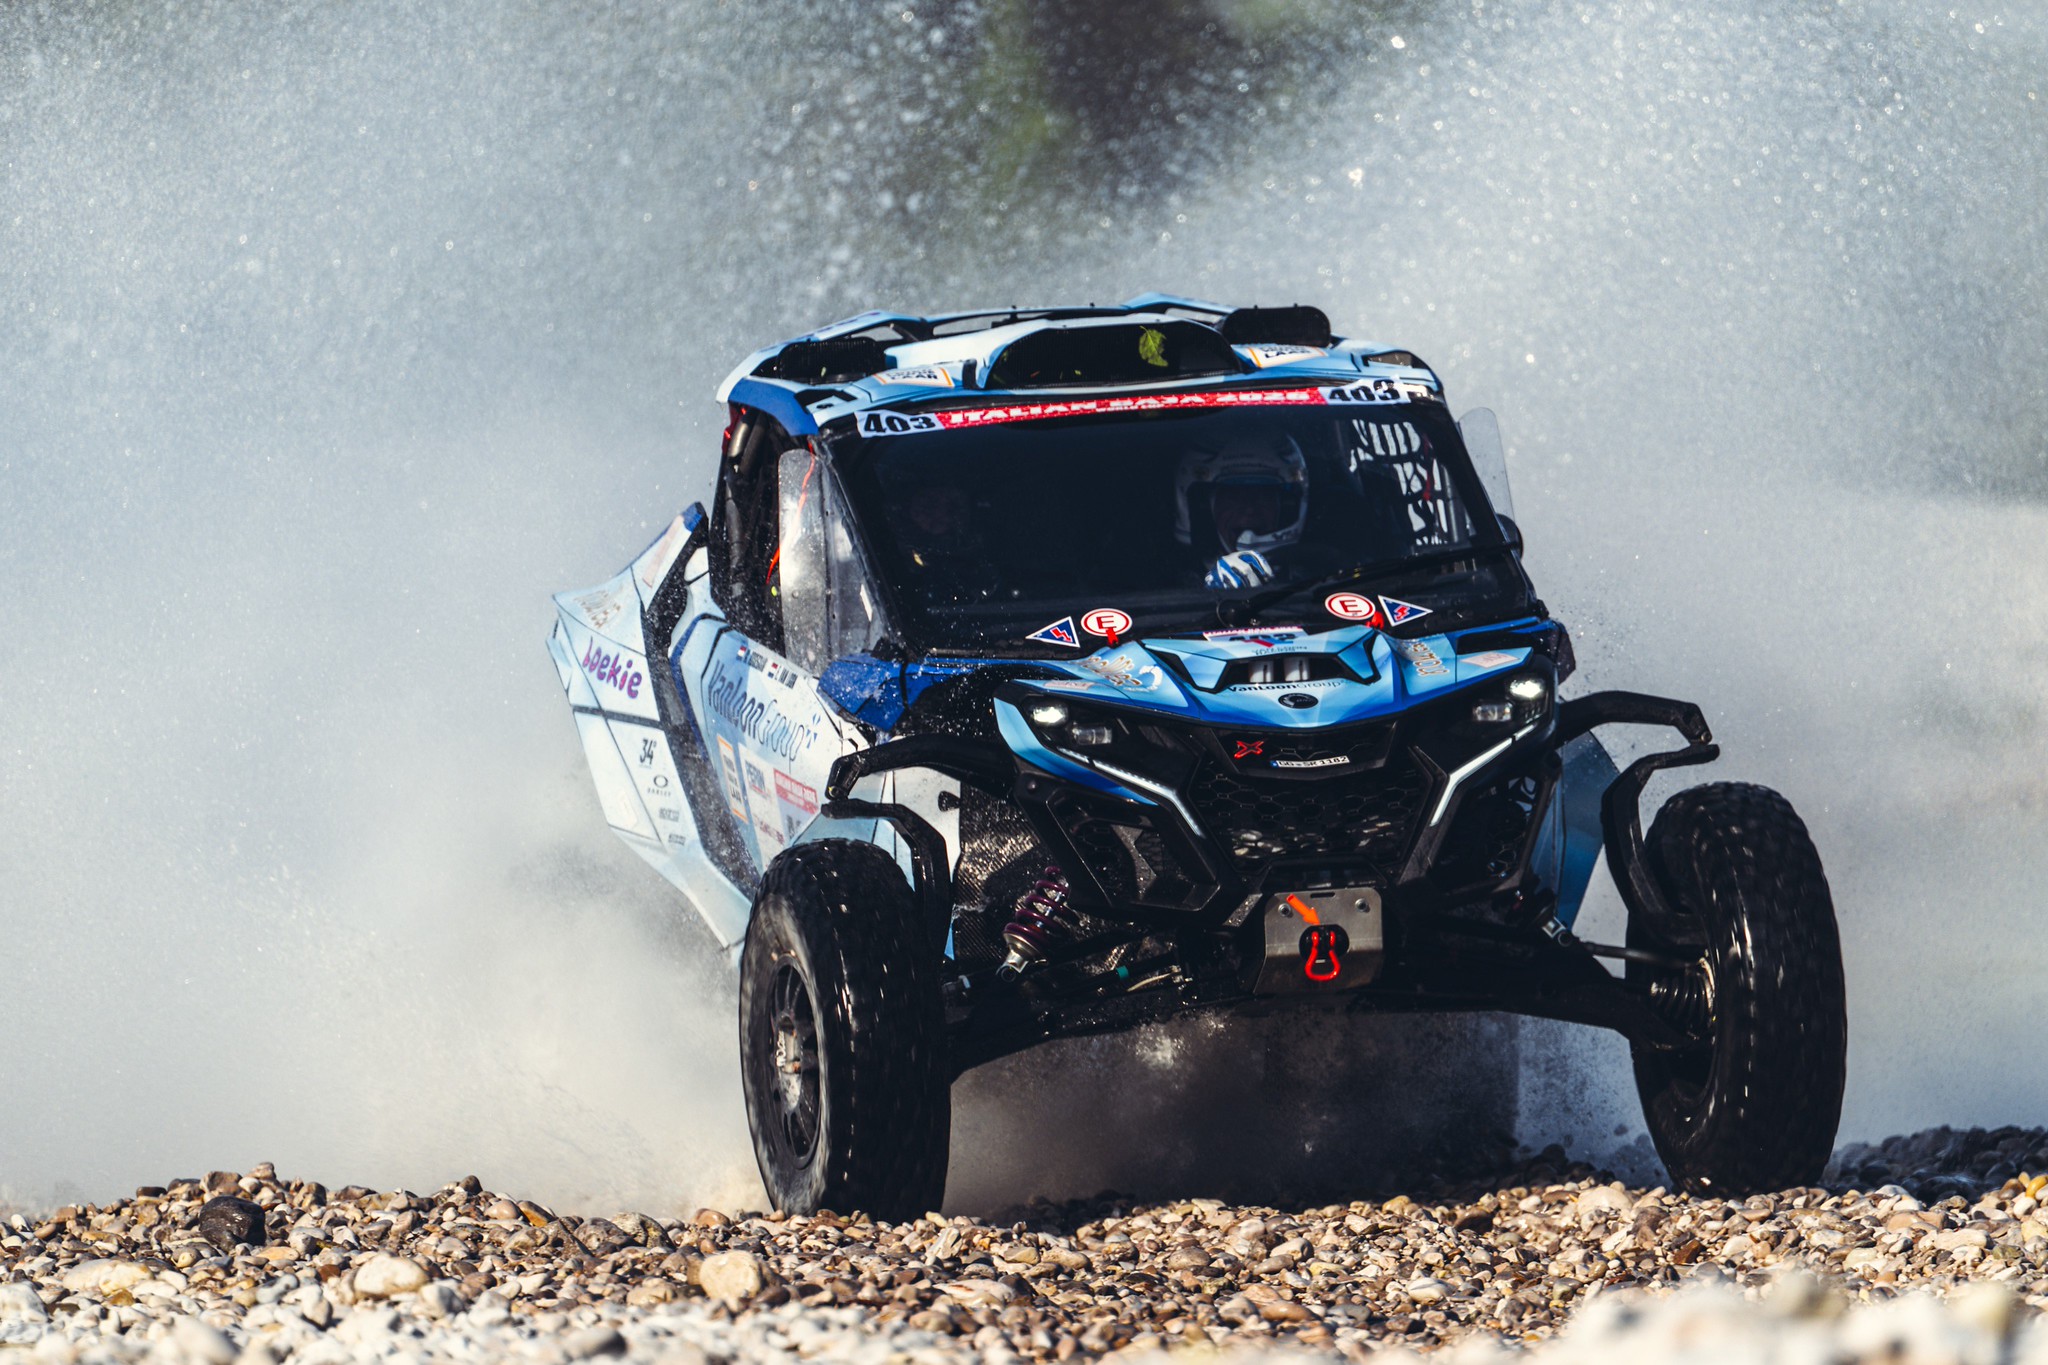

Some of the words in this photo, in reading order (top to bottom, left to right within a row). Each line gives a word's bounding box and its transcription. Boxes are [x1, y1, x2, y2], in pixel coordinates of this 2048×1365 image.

[1328, 379, 1401, 402] 403
[951, 401, 1097, 424] ITALIAN
[863, 412, 936, 434] 403
[1339, 599, 1363, 613] E
[1096, 614, 1118, 630] E
[1227, 680, 1341, 693] VanLoonGroup
